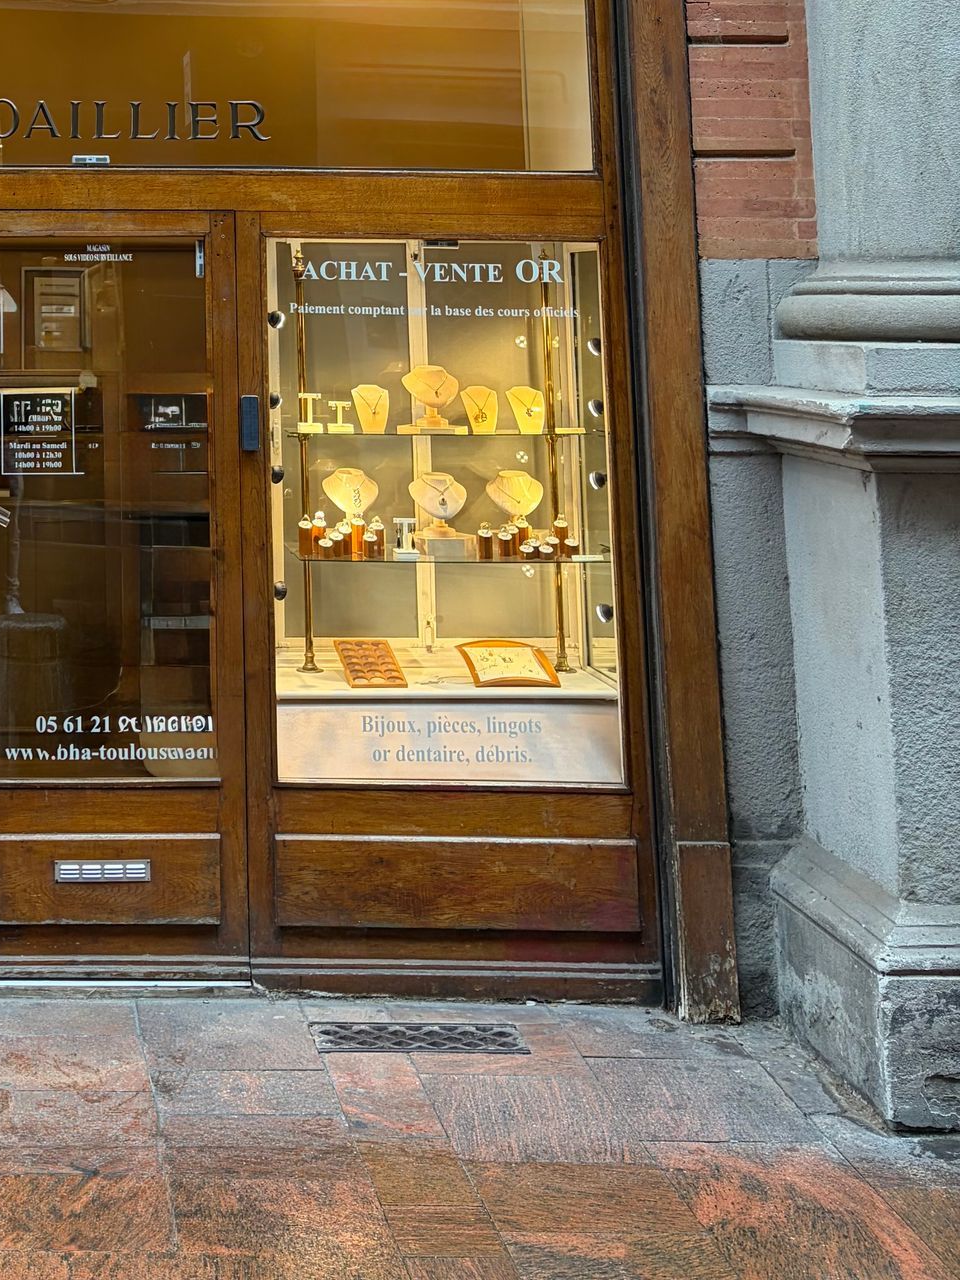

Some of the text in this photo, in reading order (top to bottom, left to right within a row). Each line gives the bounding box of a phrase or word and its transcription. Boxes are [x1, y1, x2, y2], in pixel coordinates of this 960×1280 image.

[302, 261, 392, 282] ACHAT
[413, 262, 503, 282] VENTE
[515, 259, 564, 284] OR
[289, 302, 345, 315] Paiement
[348, 304, 405, 318] comptant
[431, 304, 442, 316] la
[445, 304, 471, 316] base
[475, 305, 494, 317] des
[497, 308, 530, 317] cours
[36, 716, 57, 733] 05
[63, 716, 83, 733] 61
[90, 716, 110, 733] 21
[361, 716, 542, 738] Bijoux, pièces, lingots
[372, 745, 532, 765] or dentaire, débris.
